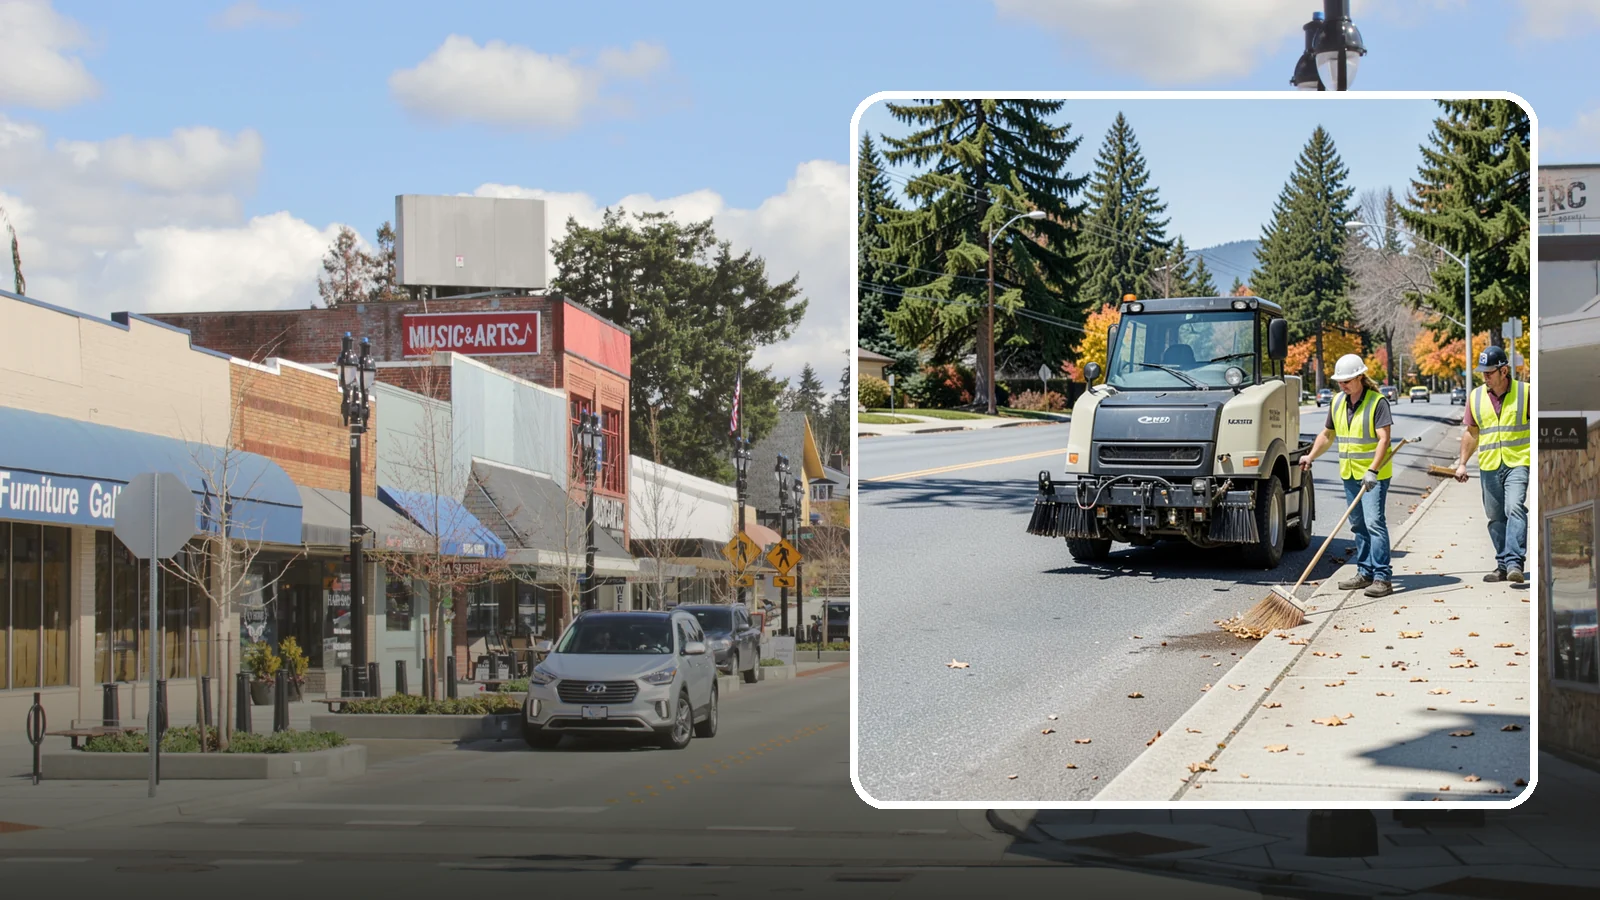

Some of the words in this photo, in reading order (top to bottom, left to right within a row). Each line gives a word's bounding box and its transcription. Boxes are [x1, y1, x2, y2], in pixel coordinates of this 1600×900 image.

[0, 470, 79, 515] Furniture
[89, 482, 122, 519] Gal
[453, 563, 479, 574] SUSHI
